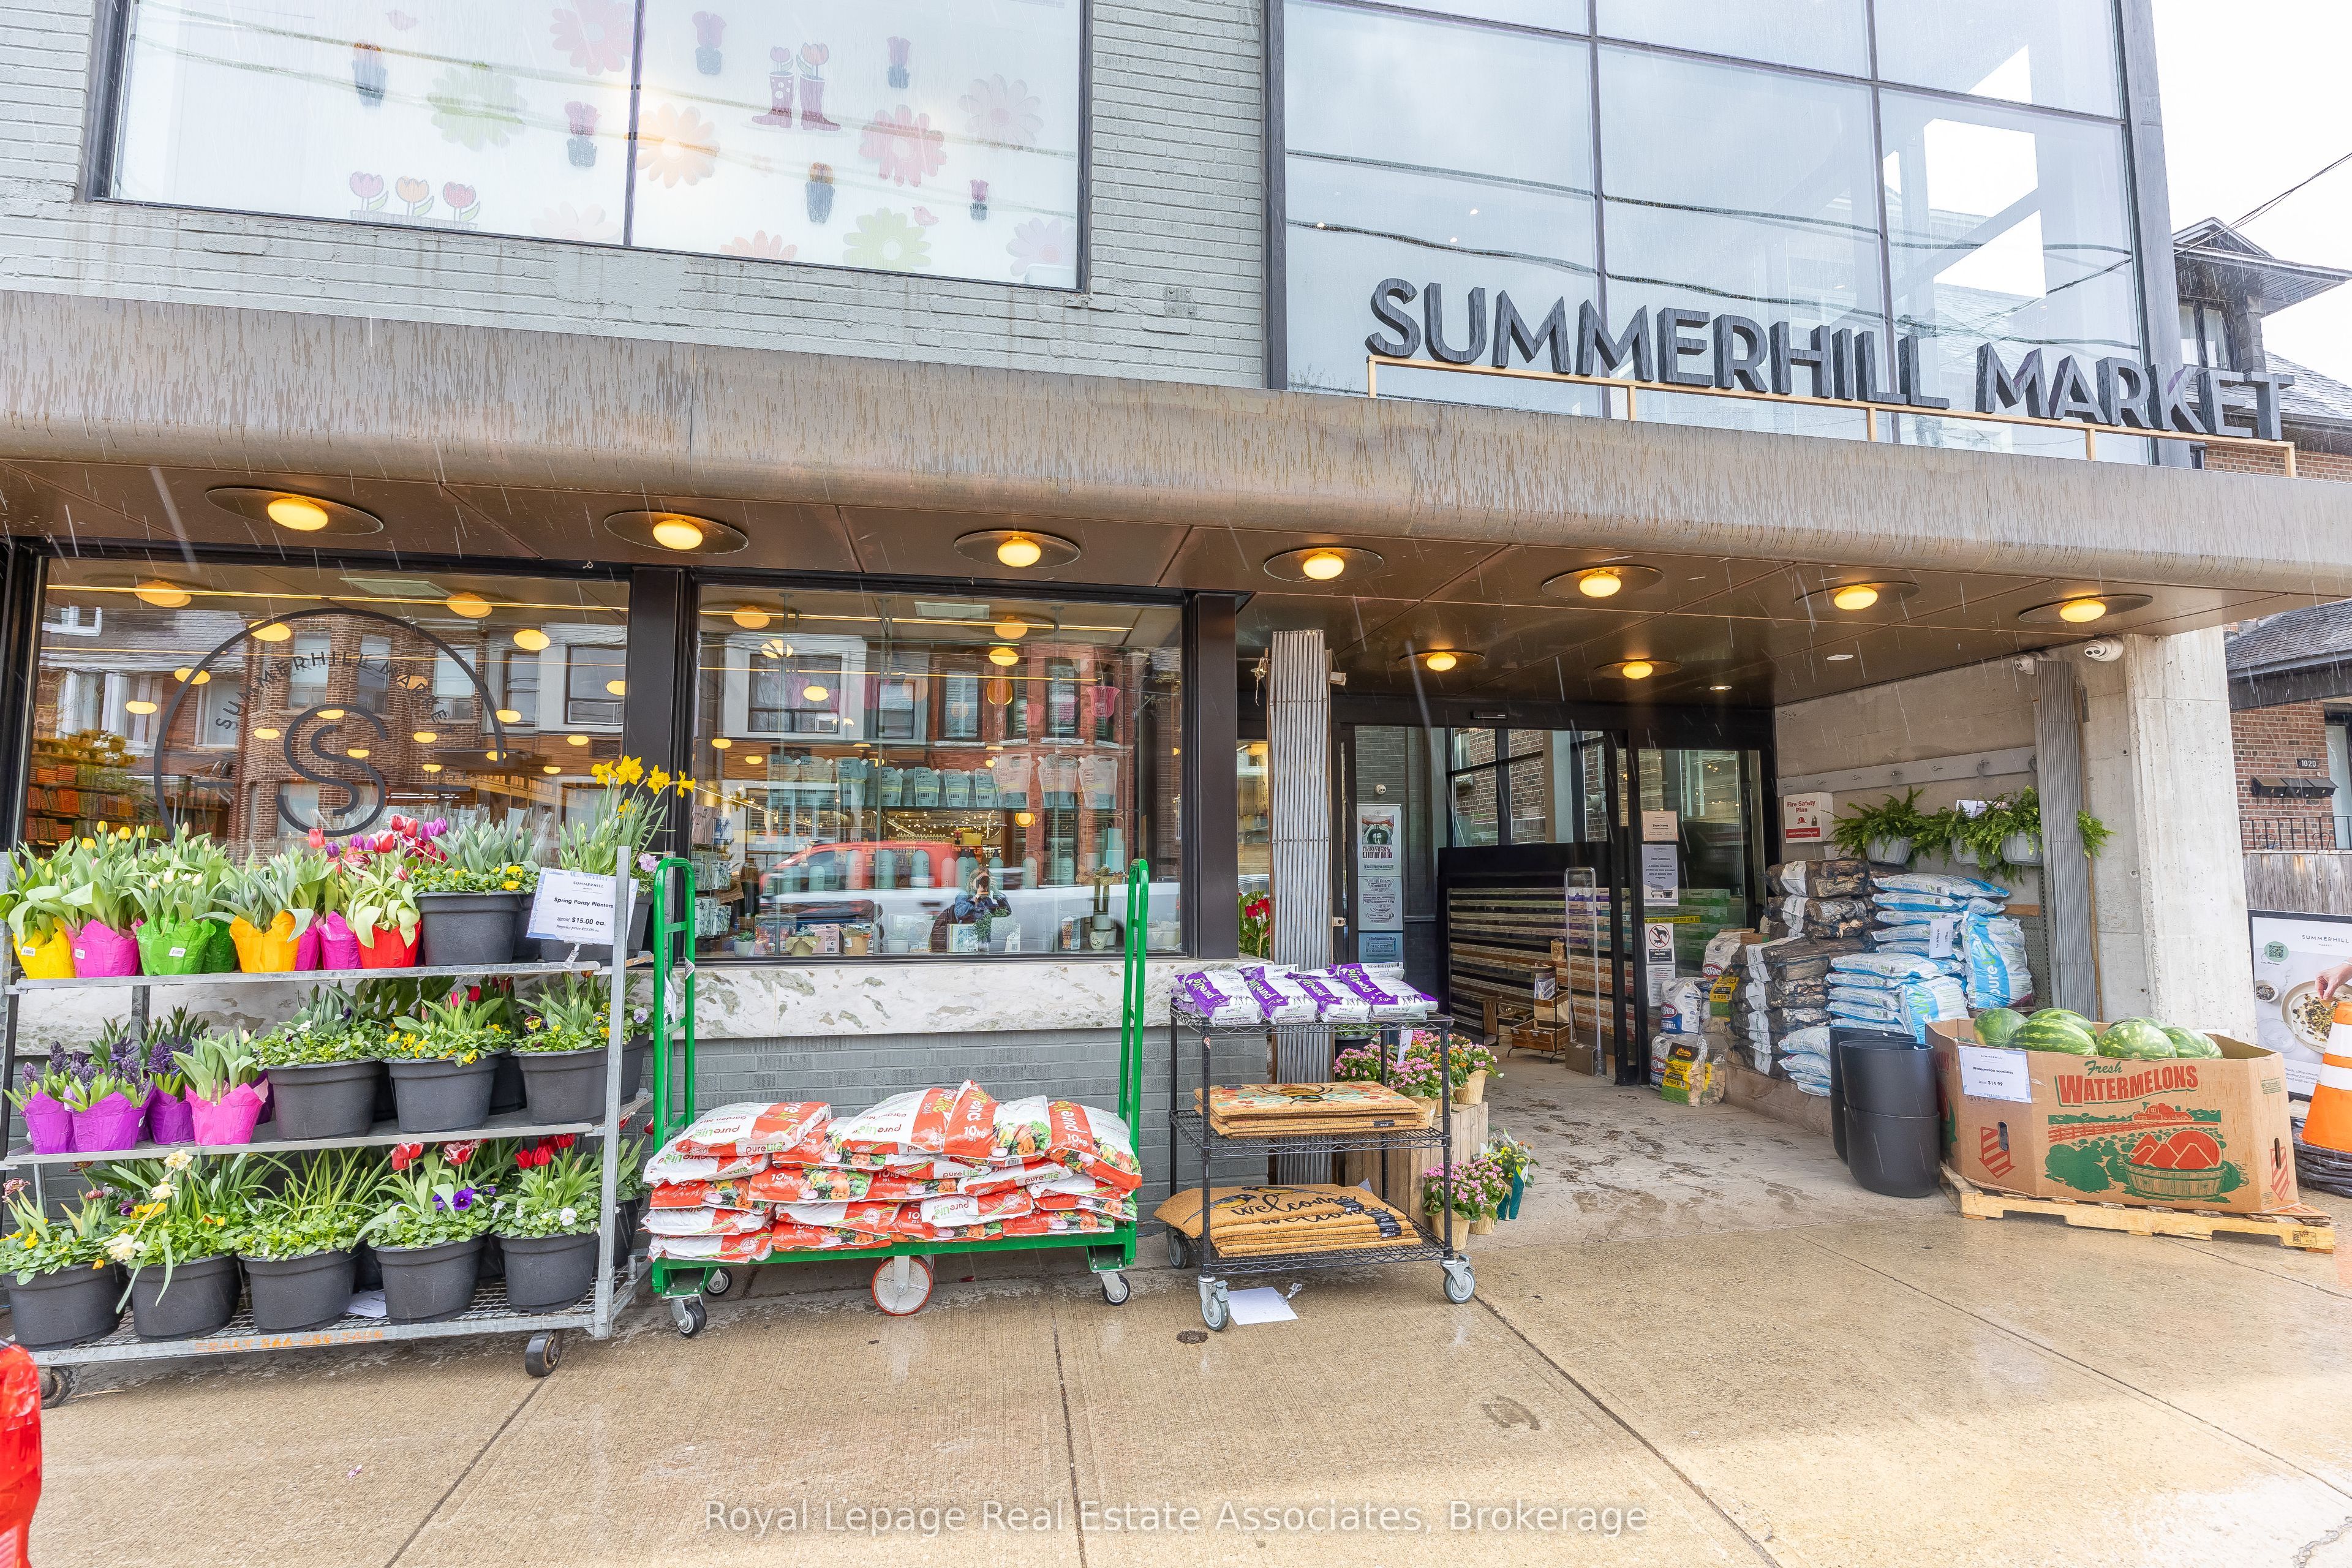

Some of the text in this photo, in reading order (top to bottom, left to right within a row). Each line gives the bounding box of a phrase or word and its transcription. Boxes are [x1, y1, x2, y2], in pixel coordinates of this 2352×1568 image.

[1365, 278, 2296, 442] SUMMERHILL MARKET
[216, 651, 368, 729] SUMMERHILL
[2084, 1060, 2122, 1076] Fresh
[2058, 1065, 2198, 1104] WATERMELONS
[695, 1125, 741, 1137] pureLife
[963, 1126, 986, 1139] 10kg
[1066, 1134, 1088, 1147] 10kg
[745, 1142, 783, 1154] pureLife
[771, 1173, 794, 1182] 10kg
[943, 1169, 979, 1178] pureLife
[1025, 1172, 1060, 1185] pureLife
[934, 1200, 970, 1216] pureLife
